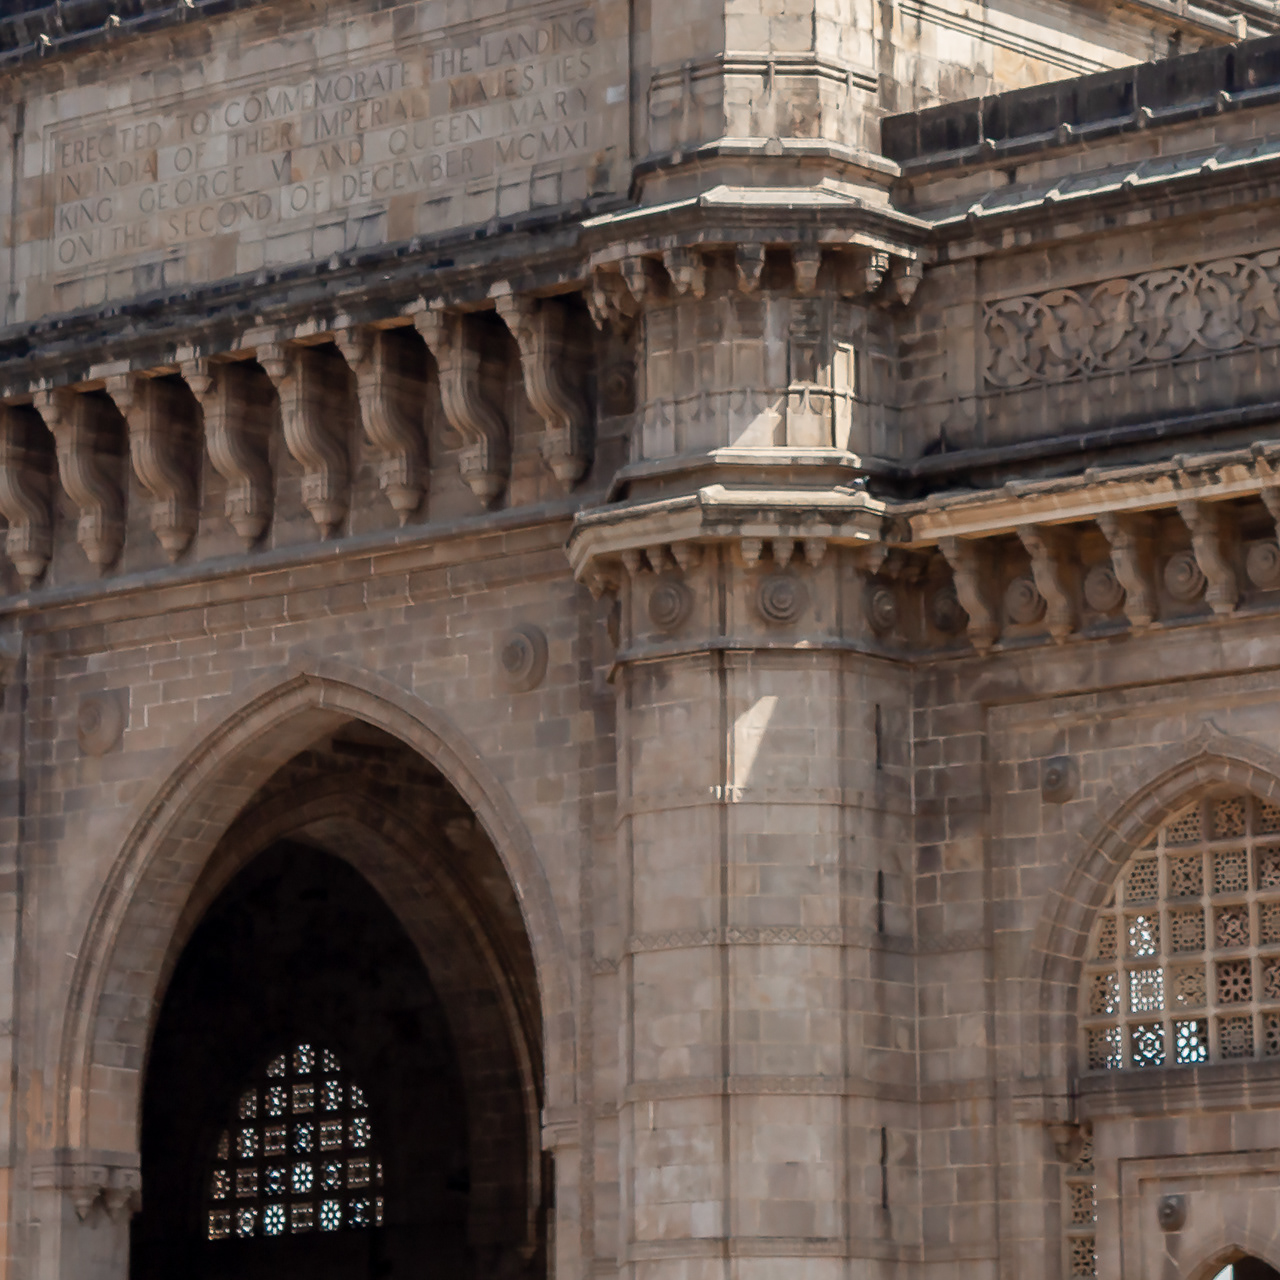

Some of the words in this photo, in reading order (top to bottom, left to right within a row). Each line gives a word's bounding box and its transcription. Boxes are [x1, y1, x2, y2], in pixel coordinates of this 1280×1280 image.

[60, 198, 112, 231] KING
[139, 166, 245, 213] GEORGE
[271, 151, 291, 181] V
[314, 140, 363, 171] AND
[389, 113, 482, 156] QUEEN
[507, 88, 587, 127] MARY
[61, 122, 162, 168] ERECTED
[176, 110, 209, 139] TO
[224, 63, 411, 127] COMMEMORATE
[426, 48, 472, 77] THE
[485, 17, 594, 67] LANDING
[61, 171, 80, 201] IN
[97, 156, 158, 192] INDIA
[174, 142, 206, 171] OF
[233, 122, 294, 158] THEIR
[314, 94, 424, 140] IMPERIAL
[450, 52, 591, 108] MAJESTIES
[58, 235, 93, 264] ON
[112, 221, 148, 251] THE
[169, 194, 272, 239] SECOND
[291, 180, 324, 211] OF
[343, 147, 473, 201] DECEMBER
[496, 121, 588, 163] MCMXI
